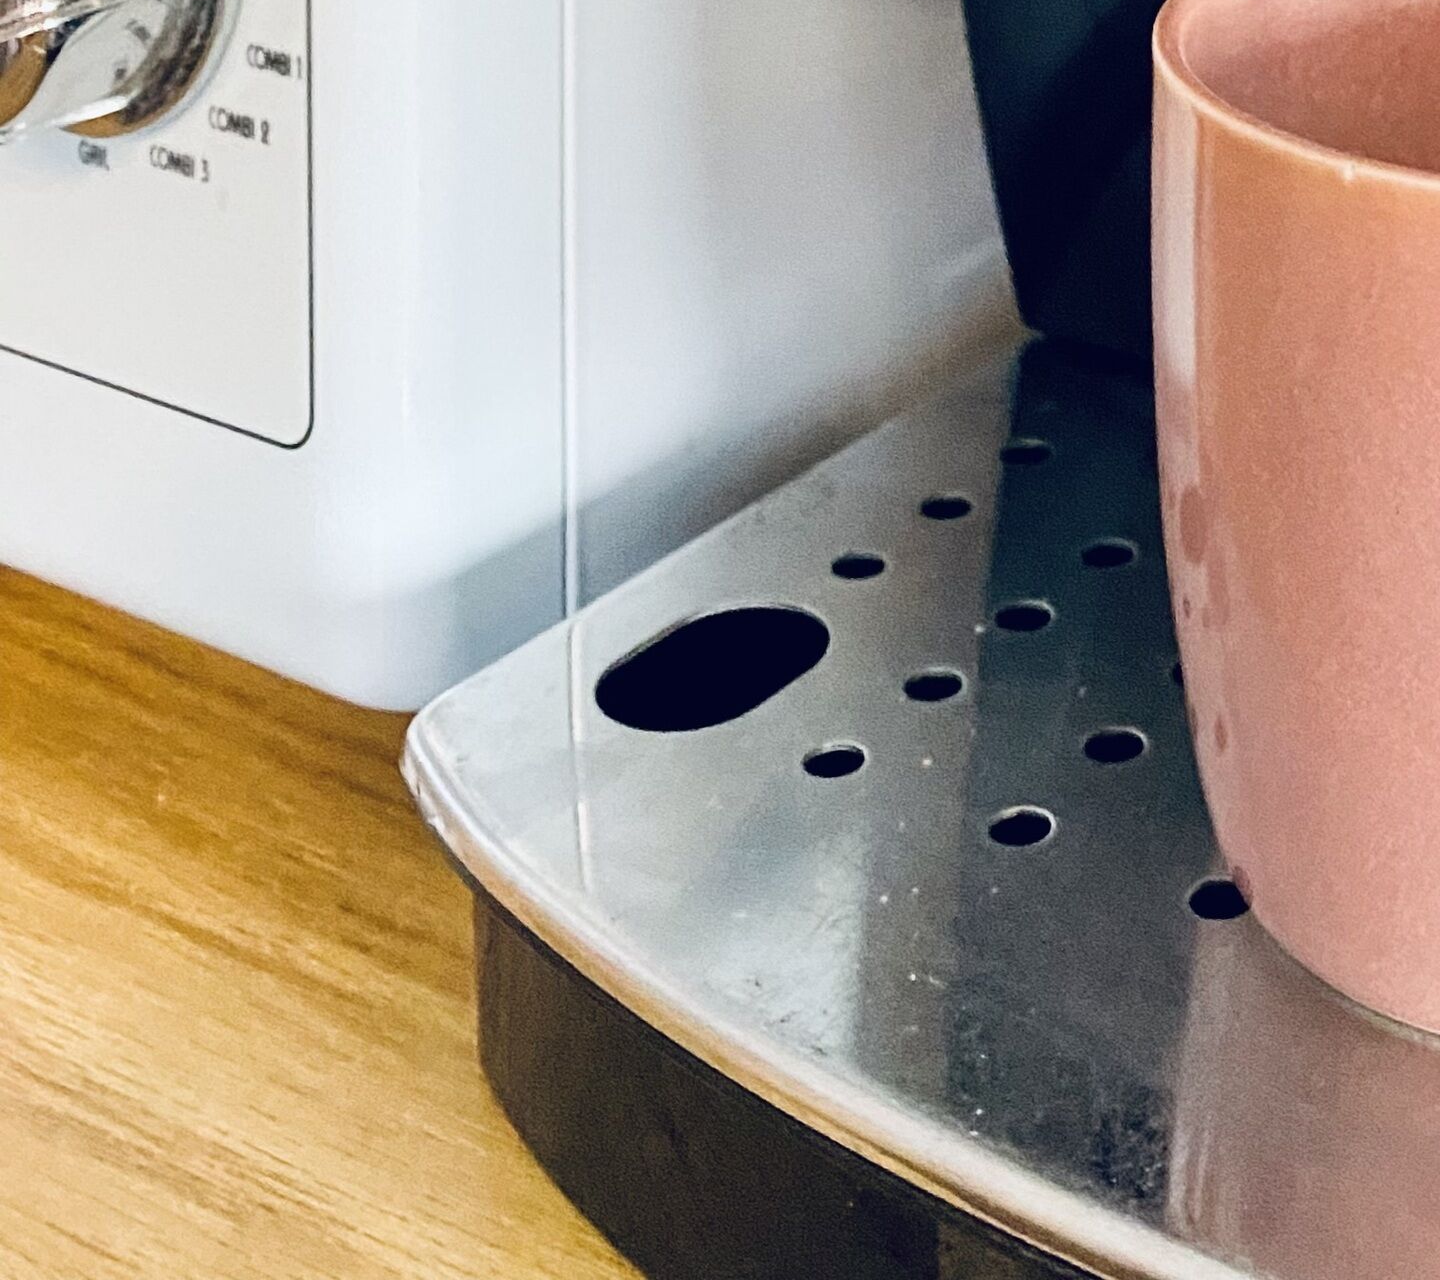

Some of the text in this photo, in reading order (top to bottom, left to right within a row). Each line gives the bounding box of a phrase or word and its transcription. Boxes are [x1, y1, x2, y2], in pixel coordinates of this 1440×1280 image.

[247, 44, 291, 77] COMBI
[208, 106, 271, 145] COMBI 2
[149, 144, 210, 183] COMBI 3
